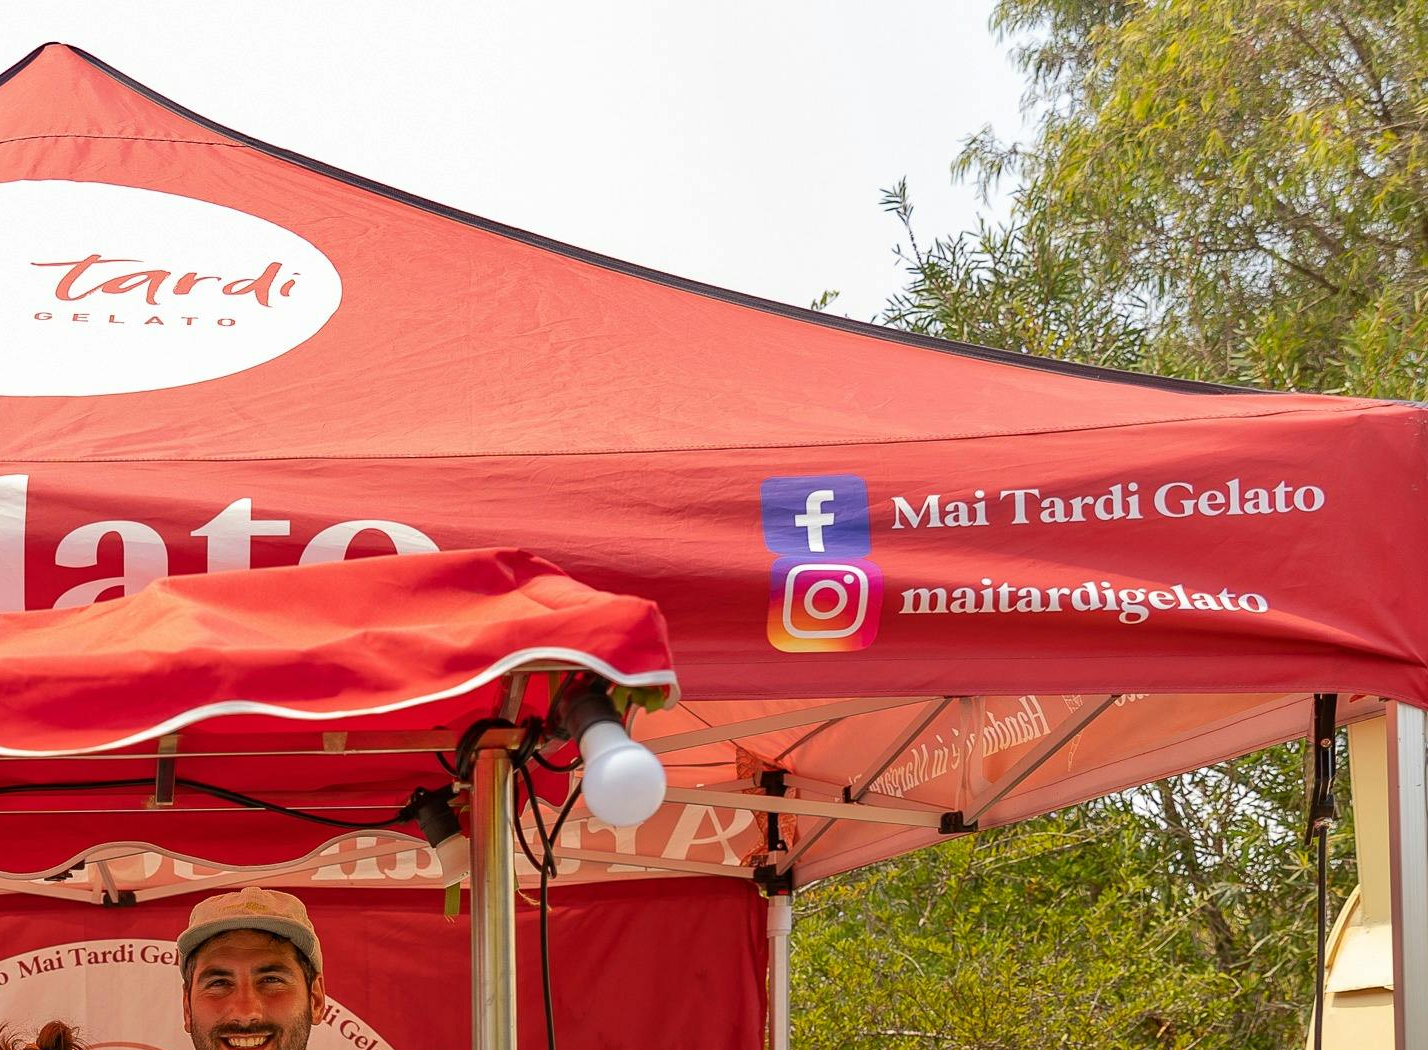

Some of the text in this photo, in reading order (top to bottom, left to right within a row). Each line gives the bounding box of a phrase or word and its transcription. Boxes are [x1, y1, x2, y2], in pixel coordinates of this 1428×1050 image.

[33, 310, 237, 328] GELATO
[891, 477, 1326, 530] Mai Tardi Gelato
[899, 577, 1269, 624] maitardigelato
[17, 950, 65, 979] Mai
[68, 943, 135, 968] Tardi
[140, 944, 179, 966] Gel
